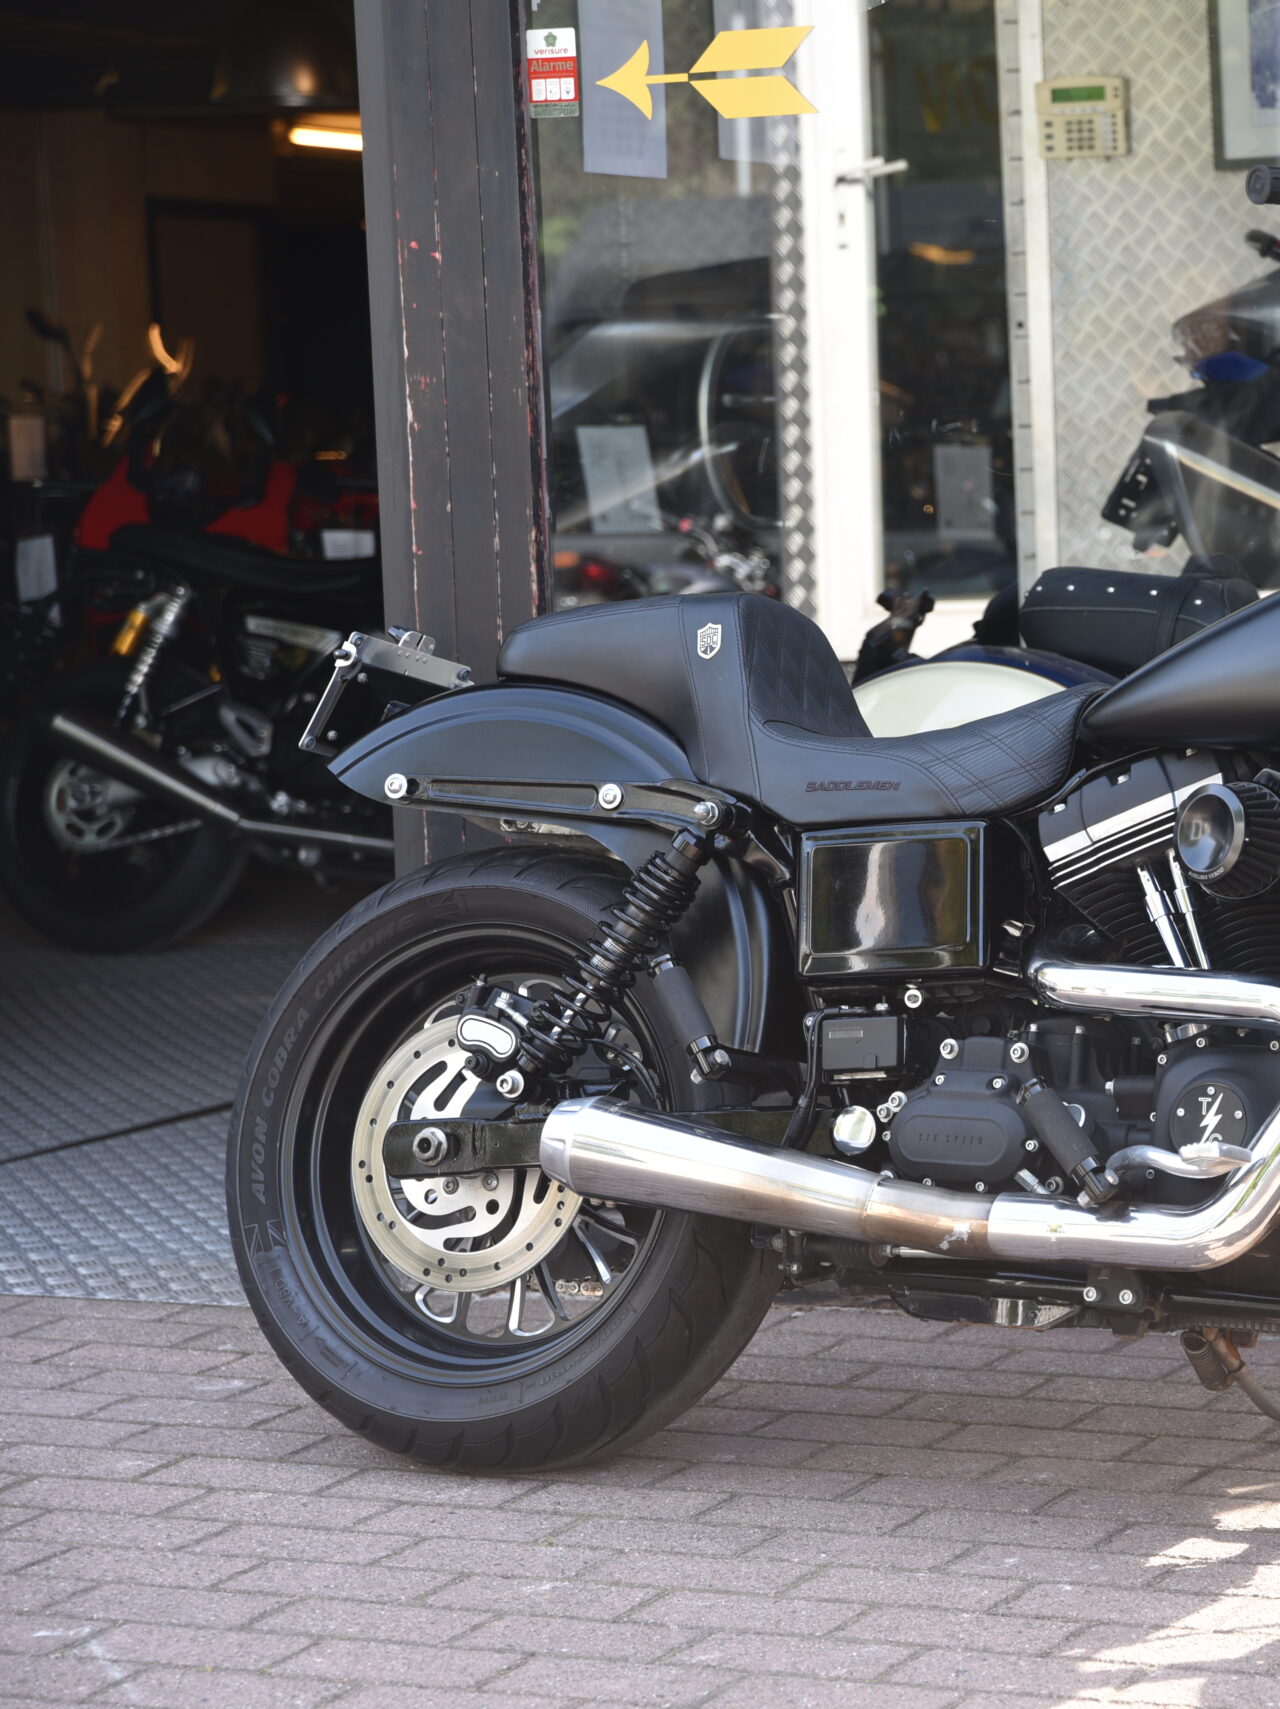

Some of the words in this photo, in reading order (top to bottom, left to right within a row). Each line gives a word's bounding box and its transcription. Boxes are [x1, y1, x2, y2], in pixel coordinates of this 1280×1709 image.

[534, 47, 569, 55] verisure
[531, 59, 574, 72] Alarme
[805, 780, 901, 792] SADDLEMEN
[252, 1116, 268, 1204] AVON
[262, 1007, 310, 1108] COBRA
[314, 912, 417, 1001] CHROME
